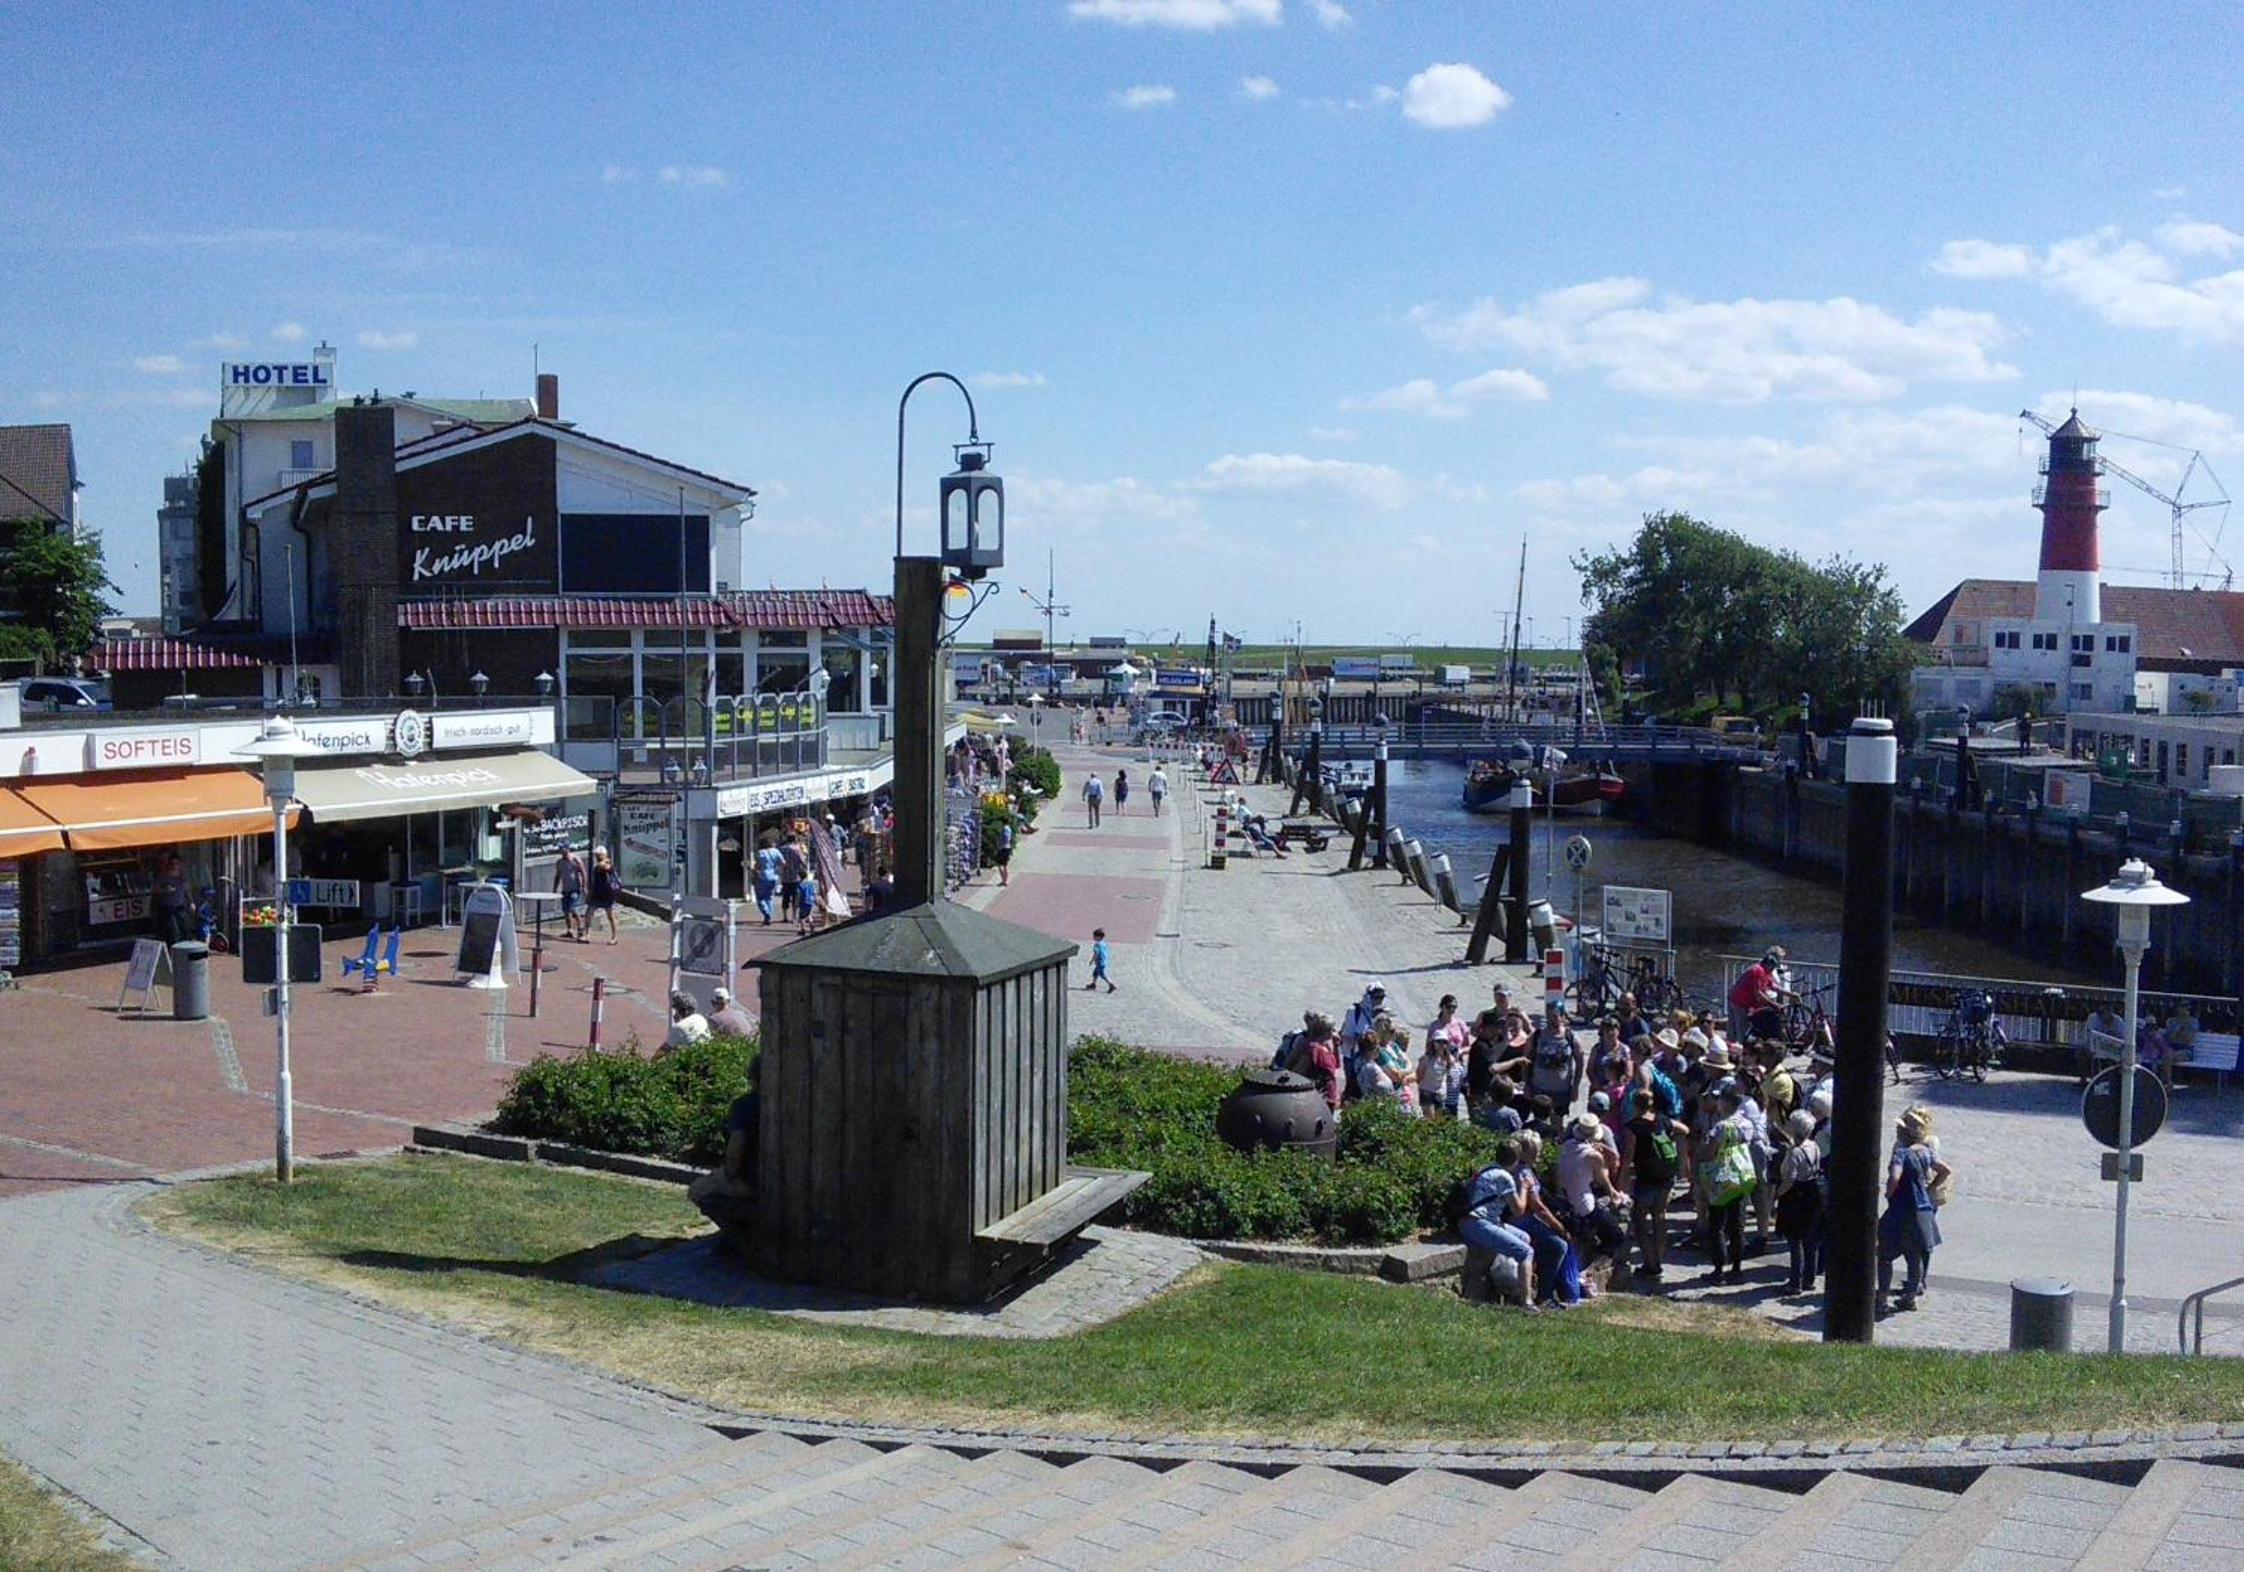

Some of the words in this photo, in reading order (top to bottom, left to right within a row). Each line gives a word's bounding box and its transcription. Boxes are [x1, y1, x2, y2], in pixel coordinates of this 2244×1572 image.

[232, 364, 327, 384] HOTEL
[411, 515, 474, 531] CAFE
[413, 515, 536, 581] Knüppel
[103, 737, 192, 760] SOFTEIS
[316, 882, 345, 903] Lift
[114, 899, 143, 919] EIS
